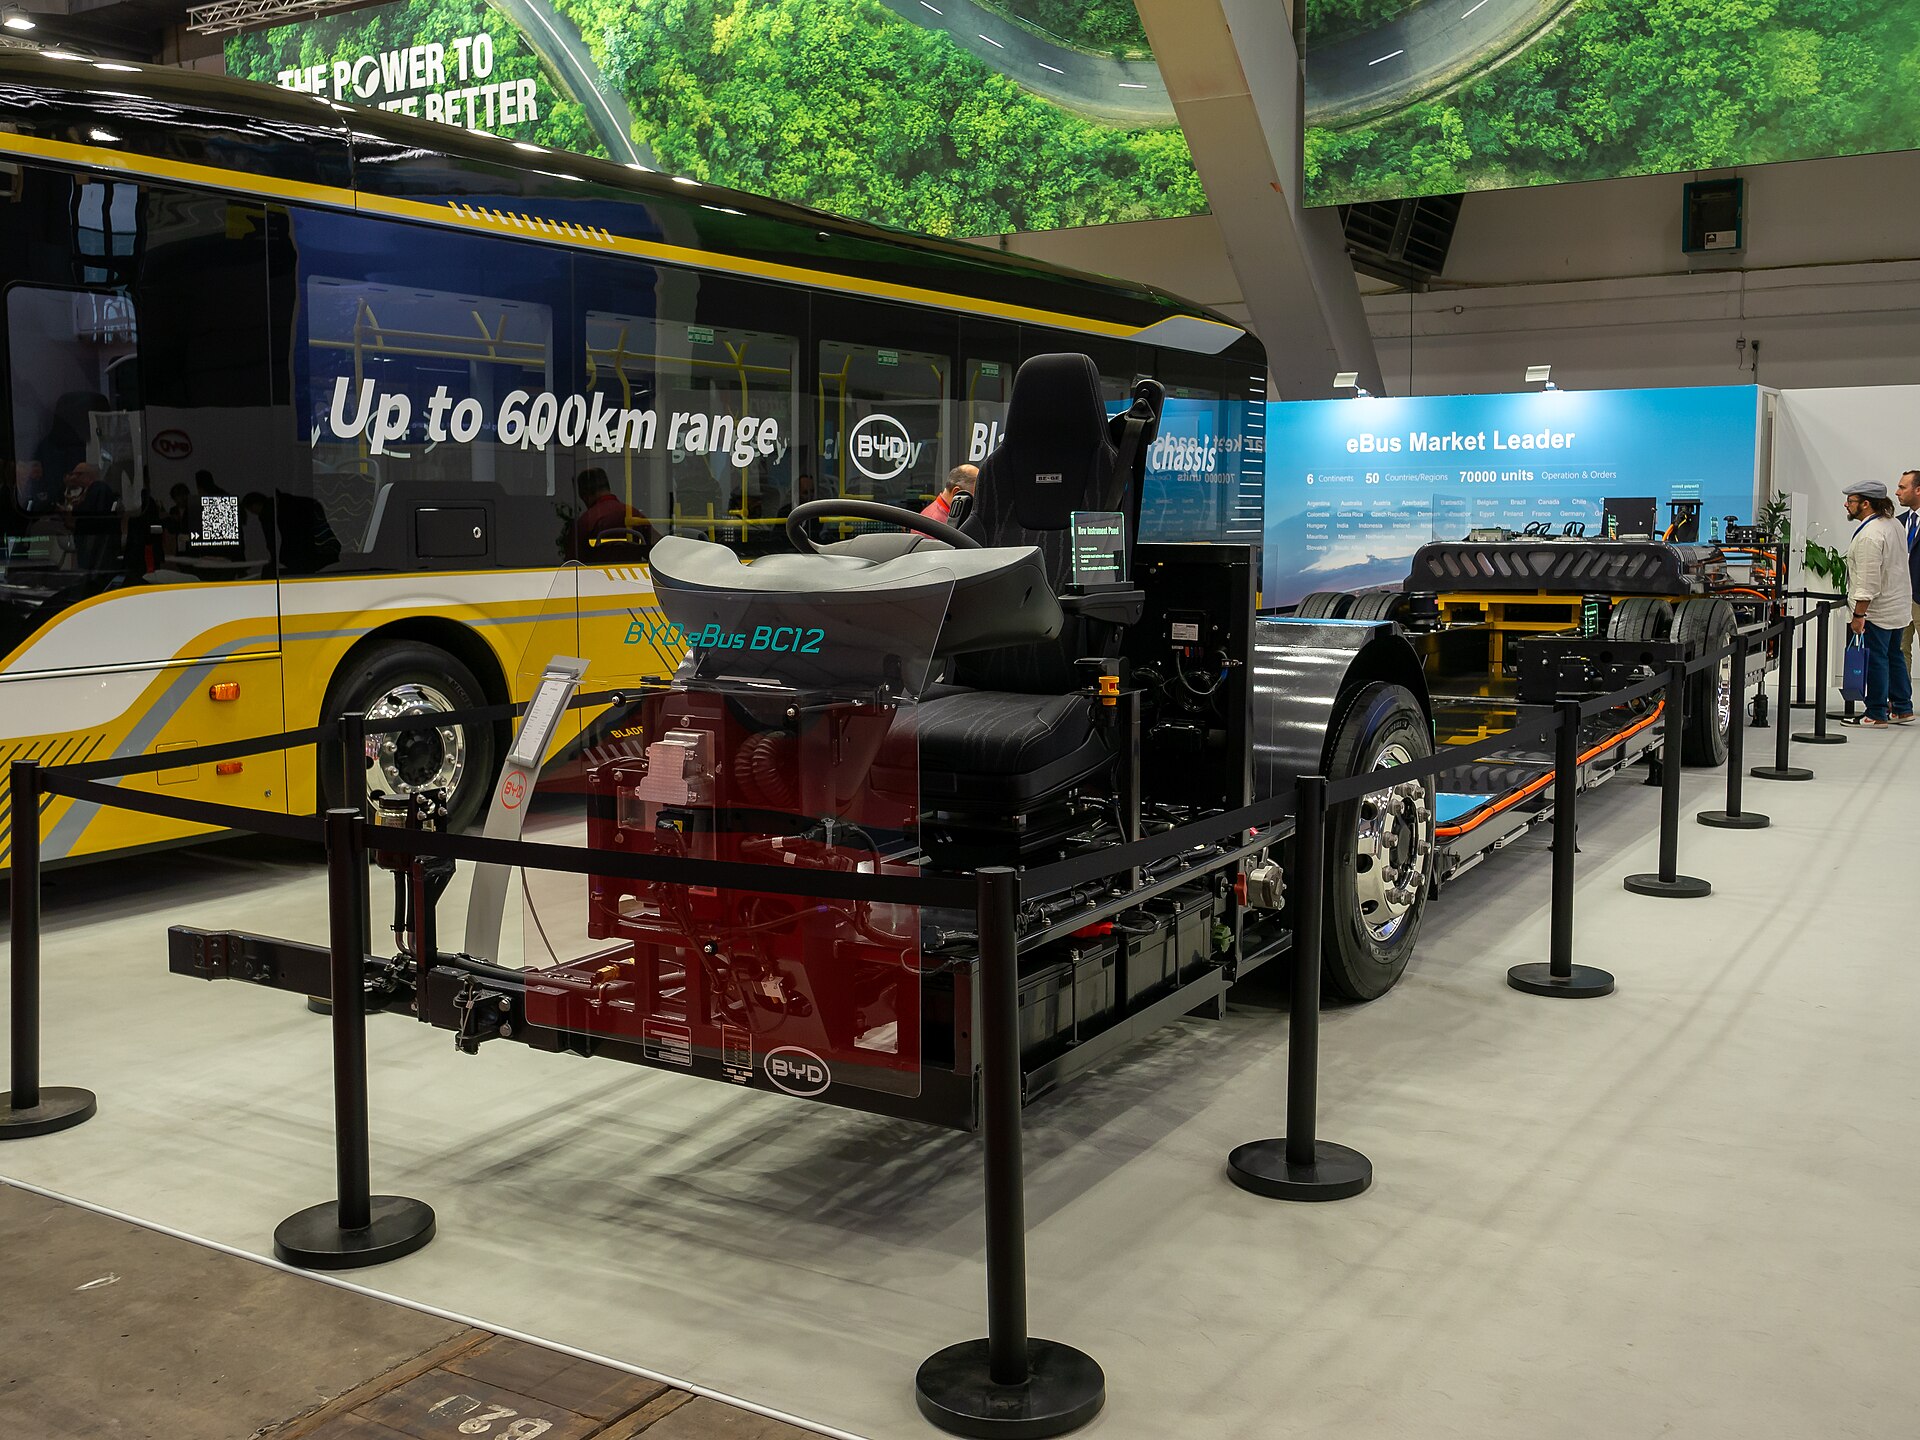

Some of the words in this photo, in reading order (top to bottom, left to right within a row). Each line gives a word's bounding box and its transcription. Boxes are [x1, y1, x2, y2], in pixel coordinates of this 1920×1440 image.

[333, 43, 446, 100] POWER
[453, 33, 494, 81] TO
[425, 78, 539, 129] BETTER
[330, 376, 411, 455] Up
[428, 386, 483, 443] to
[498, 390, 657, 450] 600km
[667, 411, 779, 468] range
[857, 433, 905, 459] BYD
[1152, 433, 1217, 472] chassis
[1346, 433, 1402, 453] eBus
[1409, 431, 1486, 452] Market
[1493, 428, 1576, 450] Leader
[1306, 473, 1314, 485] 6
[1318, 474, 1354, 483] Continents
[1365, 473, 1380, 484] 50
[1385, 473, 1449, 483] Countries/Regions
[1459, 470, 1497, 482] 70000
[1501, 469, 1534, 481] units
[1541, 471, 1580, 481] Operation
[1582, 471, 1588, 479] &
[1590, 470, 1617, 479] Orders
[1387, 511, 1410, 519] Republic
[1559, 510, 1586, 518] Germany
[1476, 499, 1499, 507] Belgium
[623, 621, 685, 646] BYD
[686, 623, 747, 649] eBus
[749, 625, 825, 654] BC12
[771, 1057, 824, 1083] BYD
